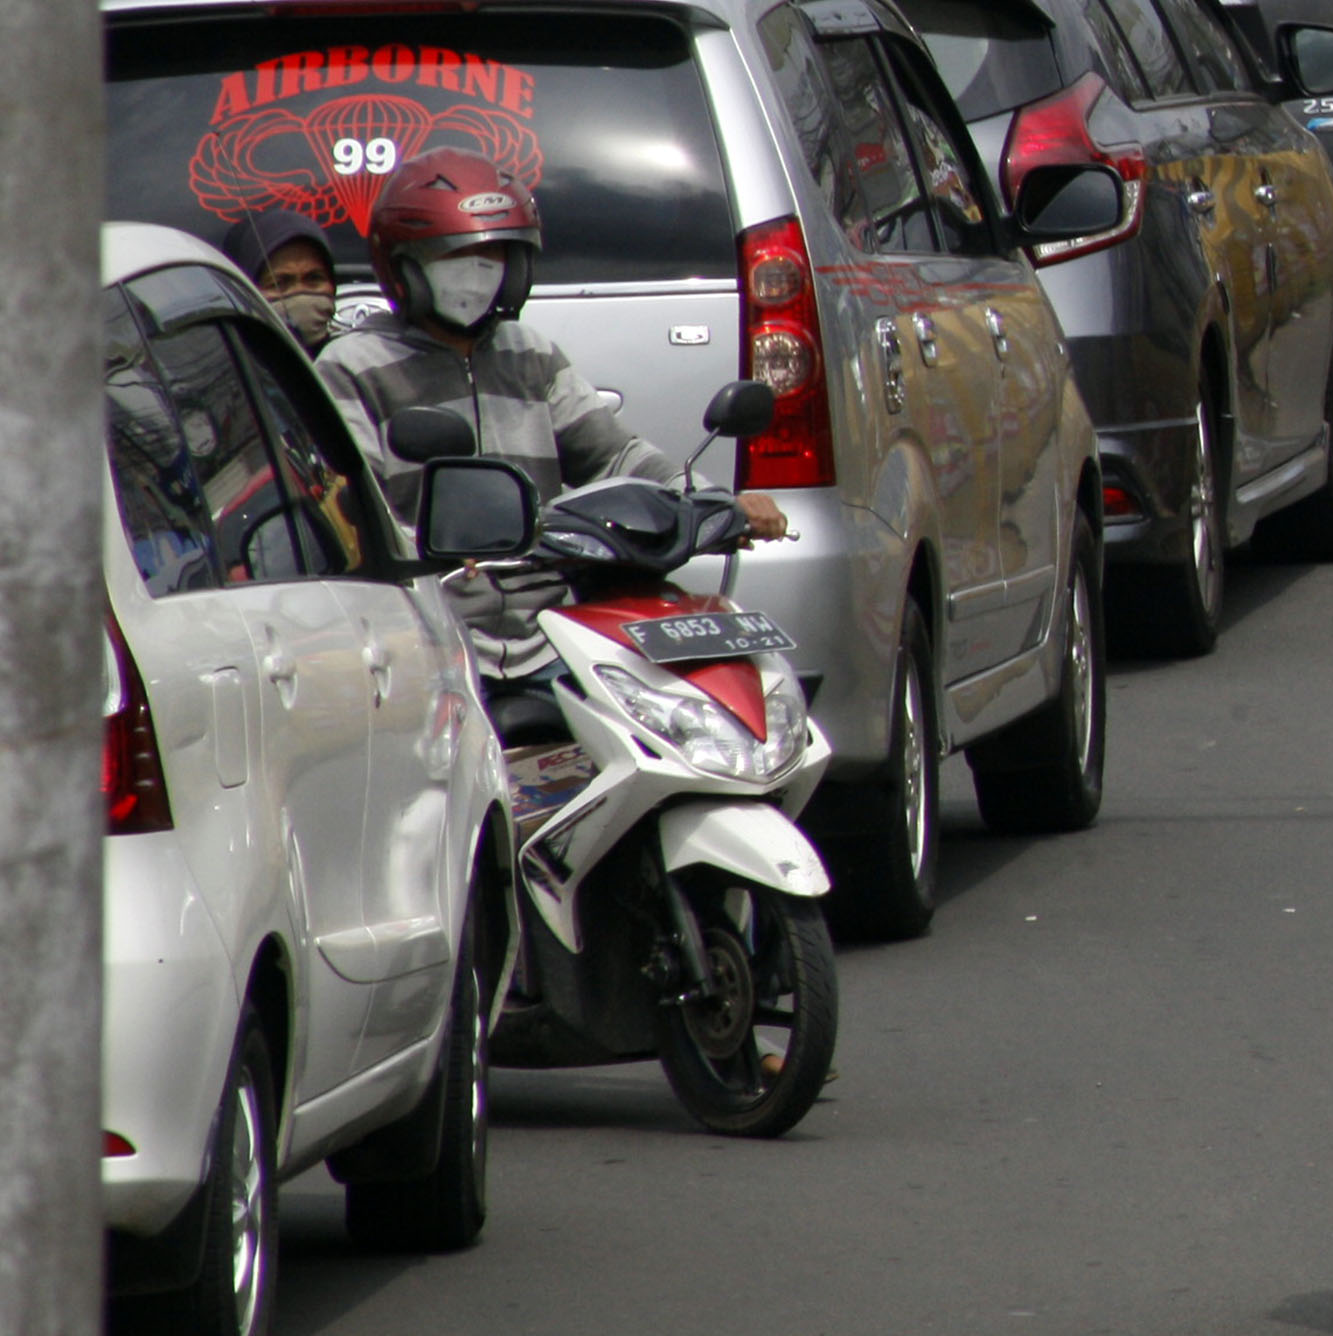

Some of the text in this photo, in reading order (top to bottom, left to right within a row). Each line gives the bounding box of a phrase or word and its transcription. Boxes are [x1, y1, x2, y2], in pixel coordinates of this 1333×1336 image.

[209, 43, 536, 125] AIRBORNE
[333, 138, 398, 176] 99
[628, 615, 774, 644] F 6853 NW
